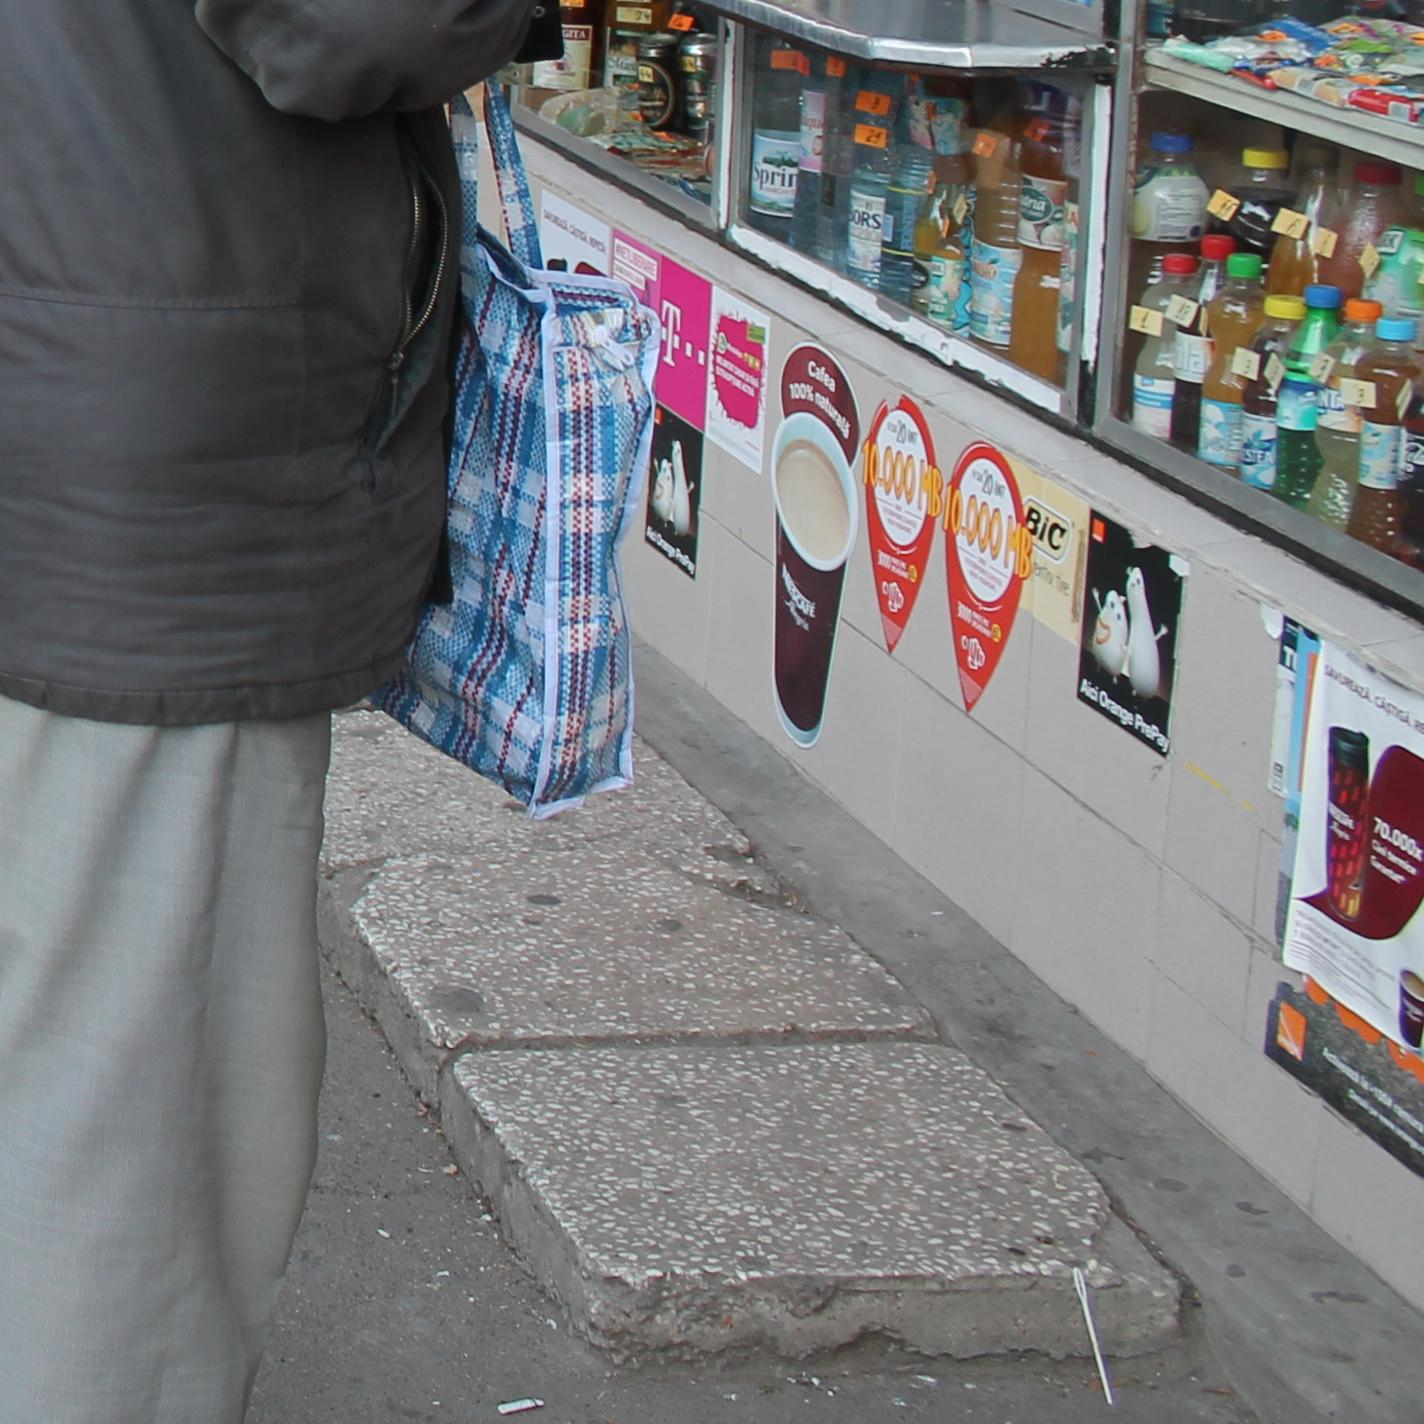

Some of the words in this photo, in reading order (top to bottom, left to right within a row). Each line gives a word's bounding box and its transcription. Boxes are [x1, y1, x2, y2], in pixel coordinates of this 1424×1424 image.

[789, 382, 814, 402] 100%
[808, 360, 836, 393] Cafea
[862, 439, 916, 506] 10.000
[918, 458, 944, 518] MB
[942, 483, 1003, 561] 10.000
[1005, 515, 1033, 580] MB
[1080, 678, 1099, 702] Aici
[1099, 690, 1134, 726] Orange
[1134, 712, 1170, 752] PrePay
[1373, 816, 1424, 862] 70.000x
